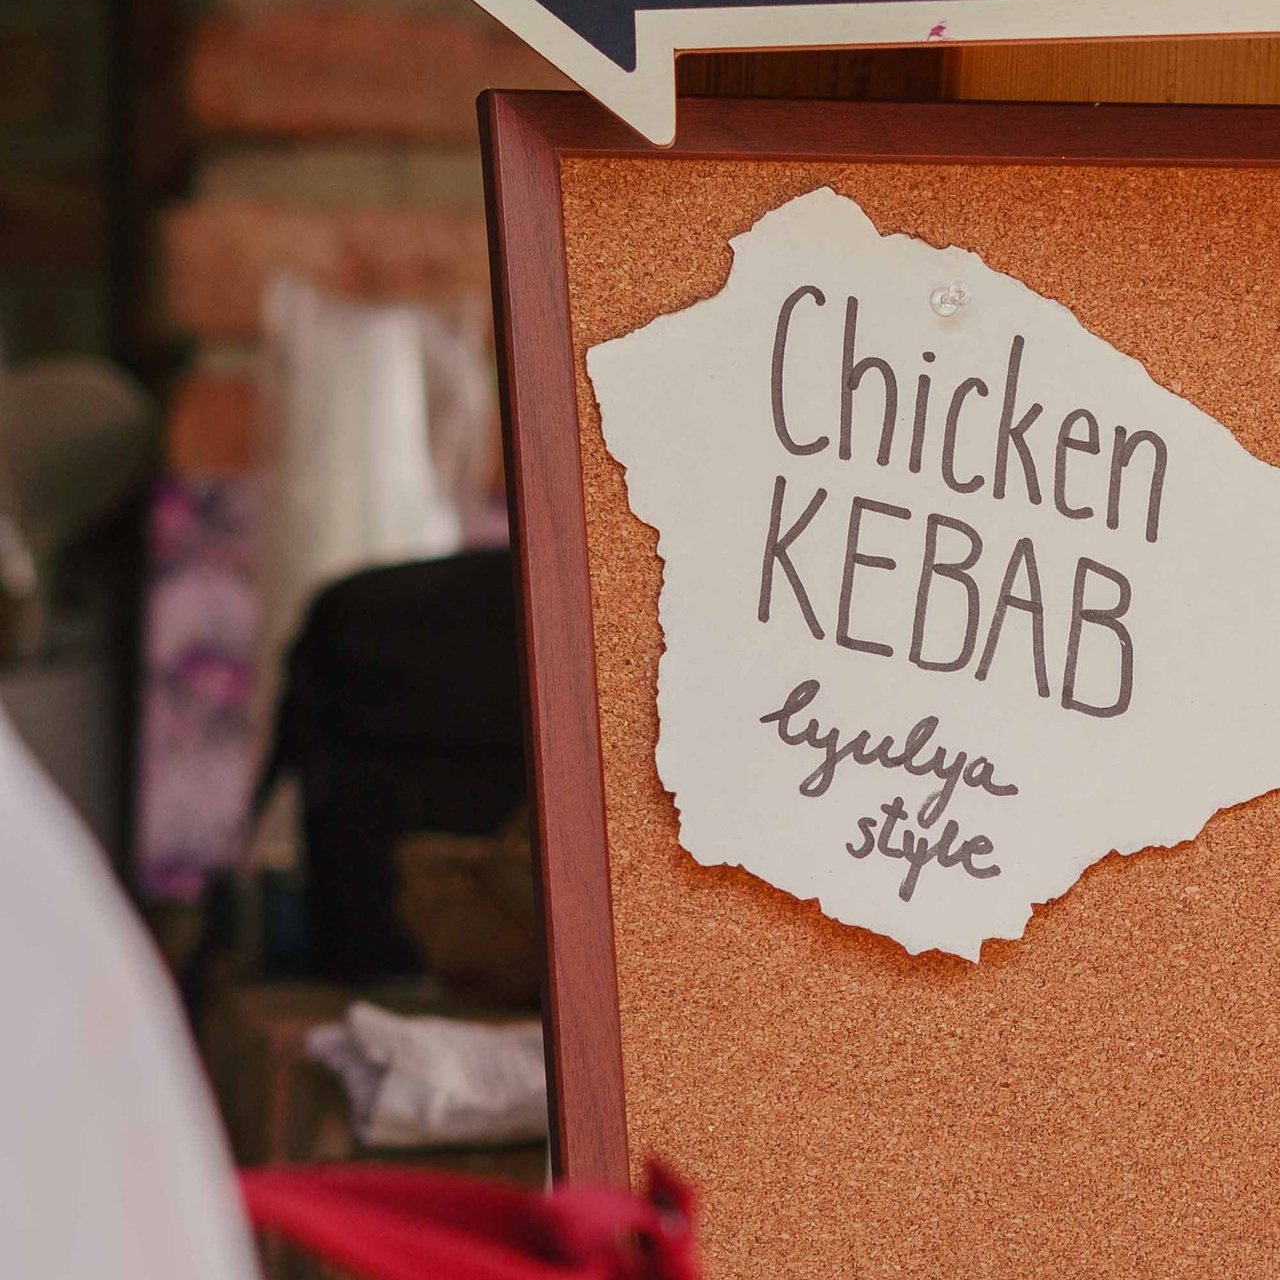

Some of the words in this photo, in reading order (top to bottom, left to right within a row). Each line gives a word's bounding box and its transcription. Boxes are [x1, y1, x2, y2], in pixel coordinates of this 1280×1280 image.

[770, 285, 1169, 542] Chicken
[757, 476, 1134, 718] KEBAB
[845, 794, 1001, 902] style
